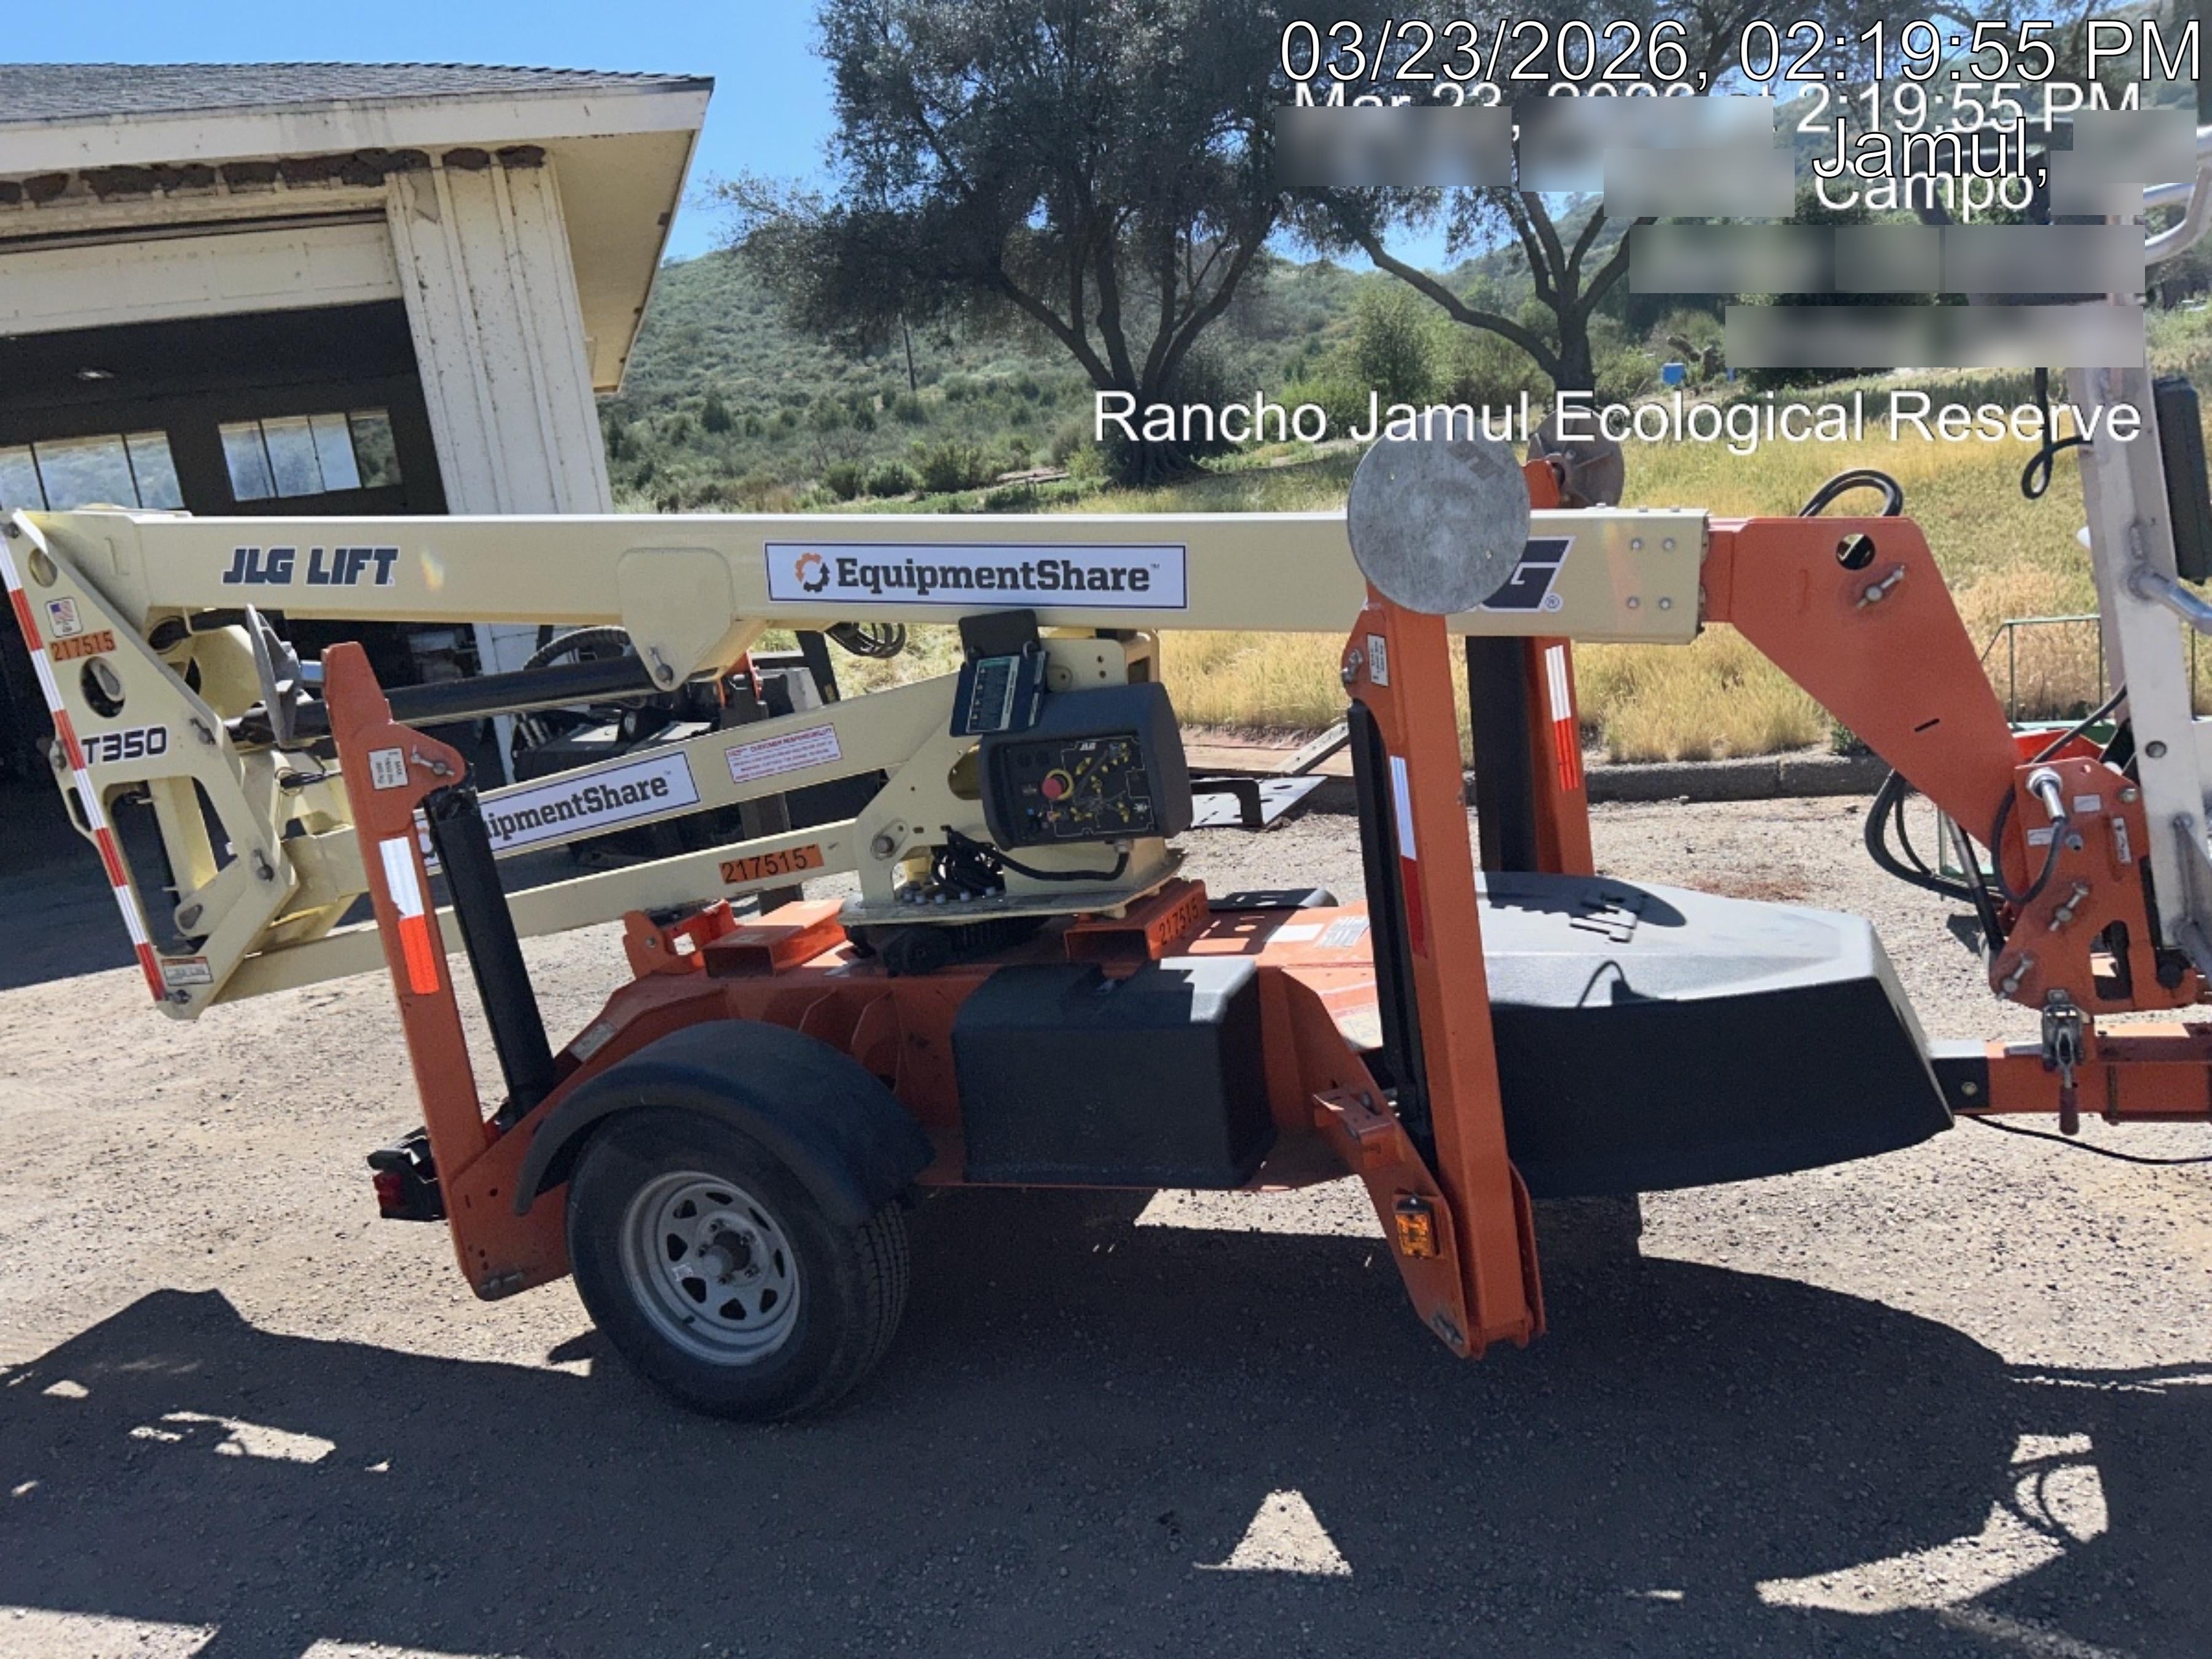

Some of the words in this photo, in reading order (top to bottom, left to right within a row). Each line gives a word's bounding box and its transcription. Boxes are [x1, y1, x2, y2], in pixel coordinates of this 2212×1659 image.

[222, 547, 296, 585] JLG
[306, 547, 399, 585] LIFT
[51, 630, 116, 662] 217515
[81, 726, 167, 764] T350
